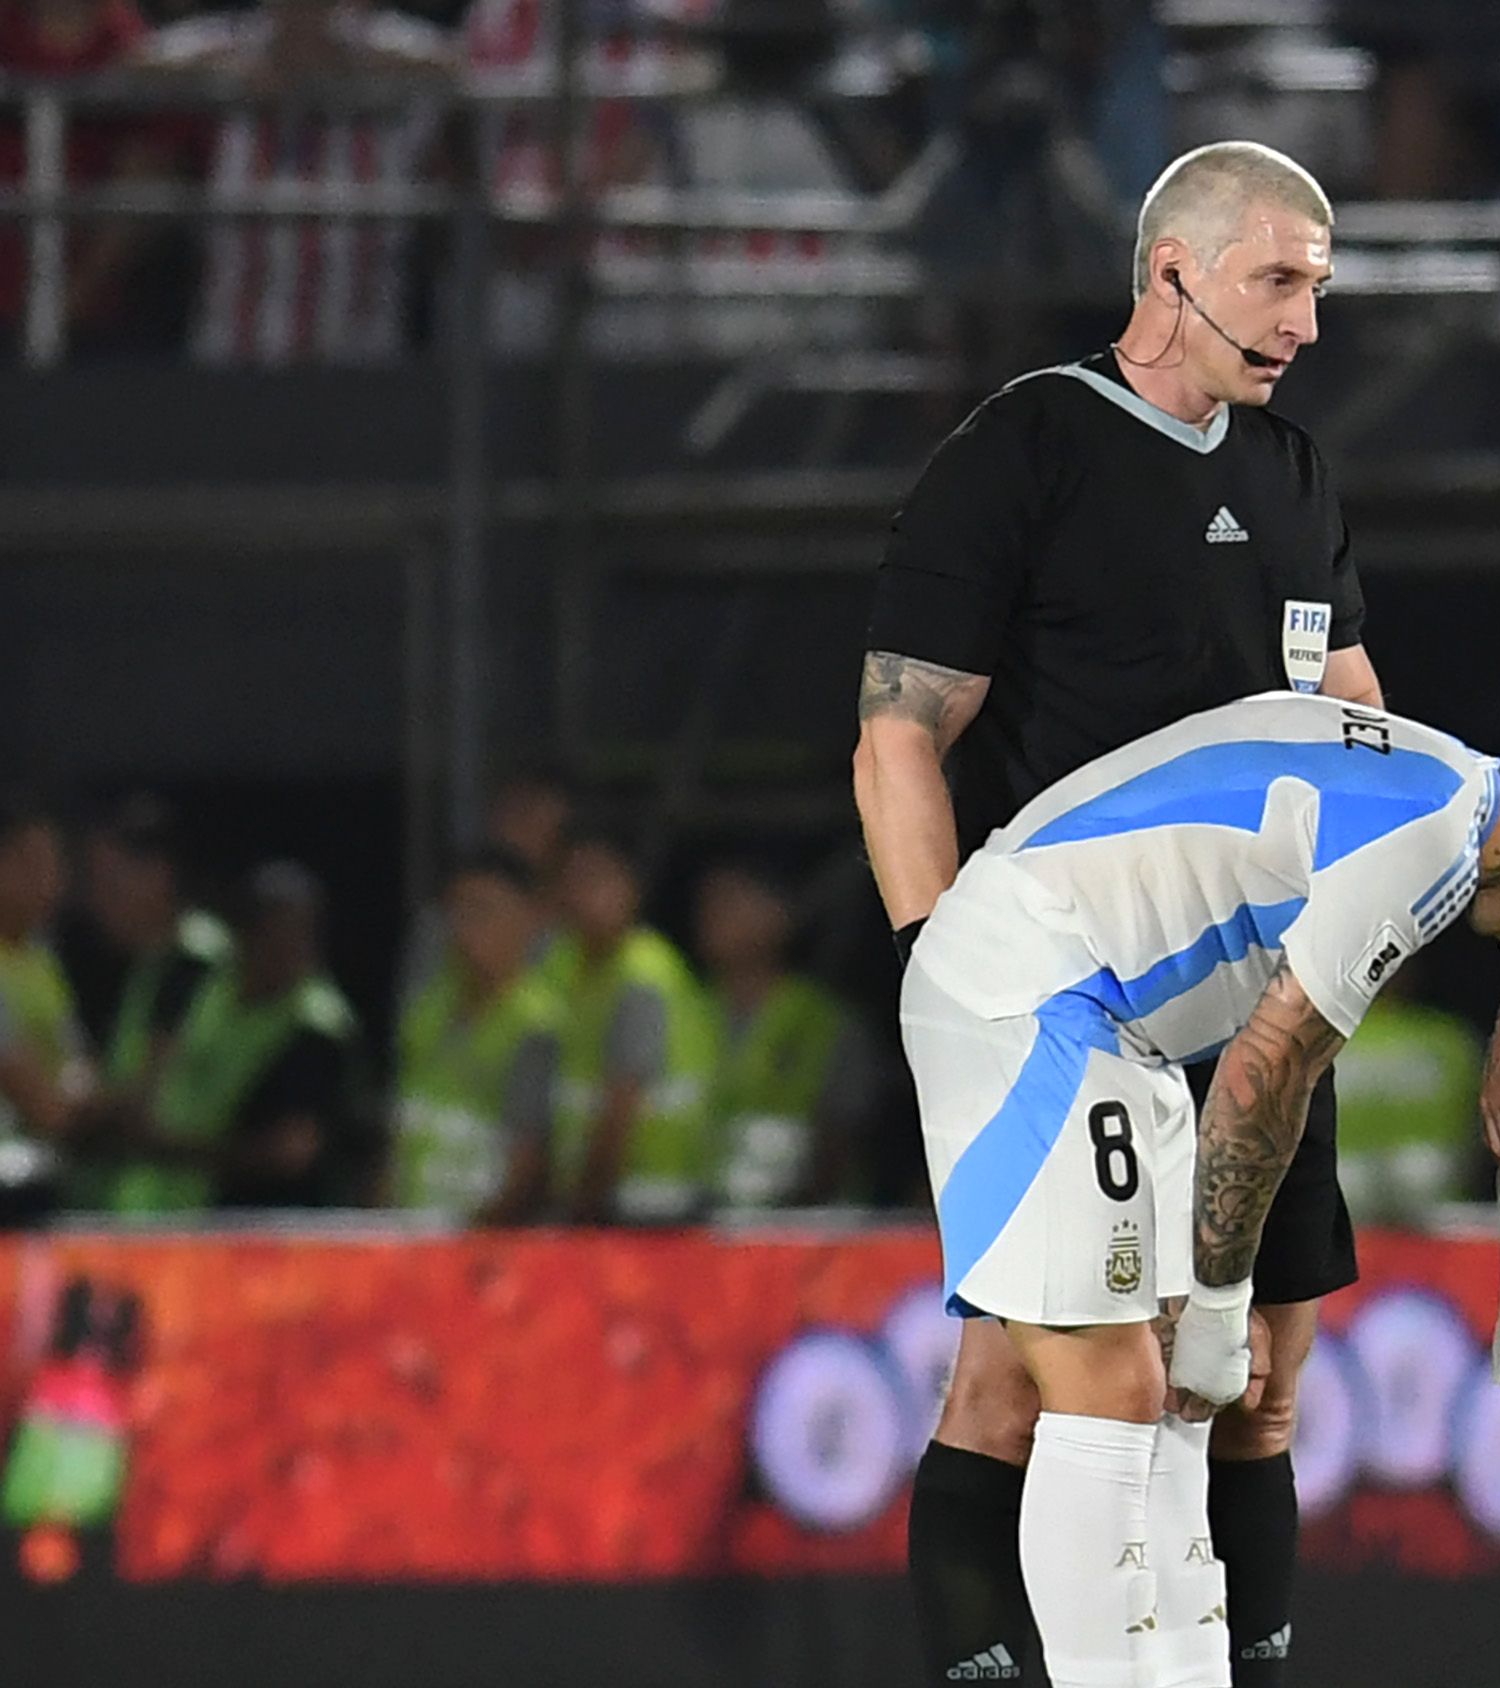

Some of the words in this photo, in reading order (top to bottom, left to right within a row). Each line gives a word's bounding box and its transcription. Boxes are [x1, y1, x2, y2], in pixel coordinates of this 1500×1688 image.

[1205, 529, 1249, 544] adidas
[1290, 608, 1327, 634] FIFA
[1088, 1099, 1140, 1203] 8
